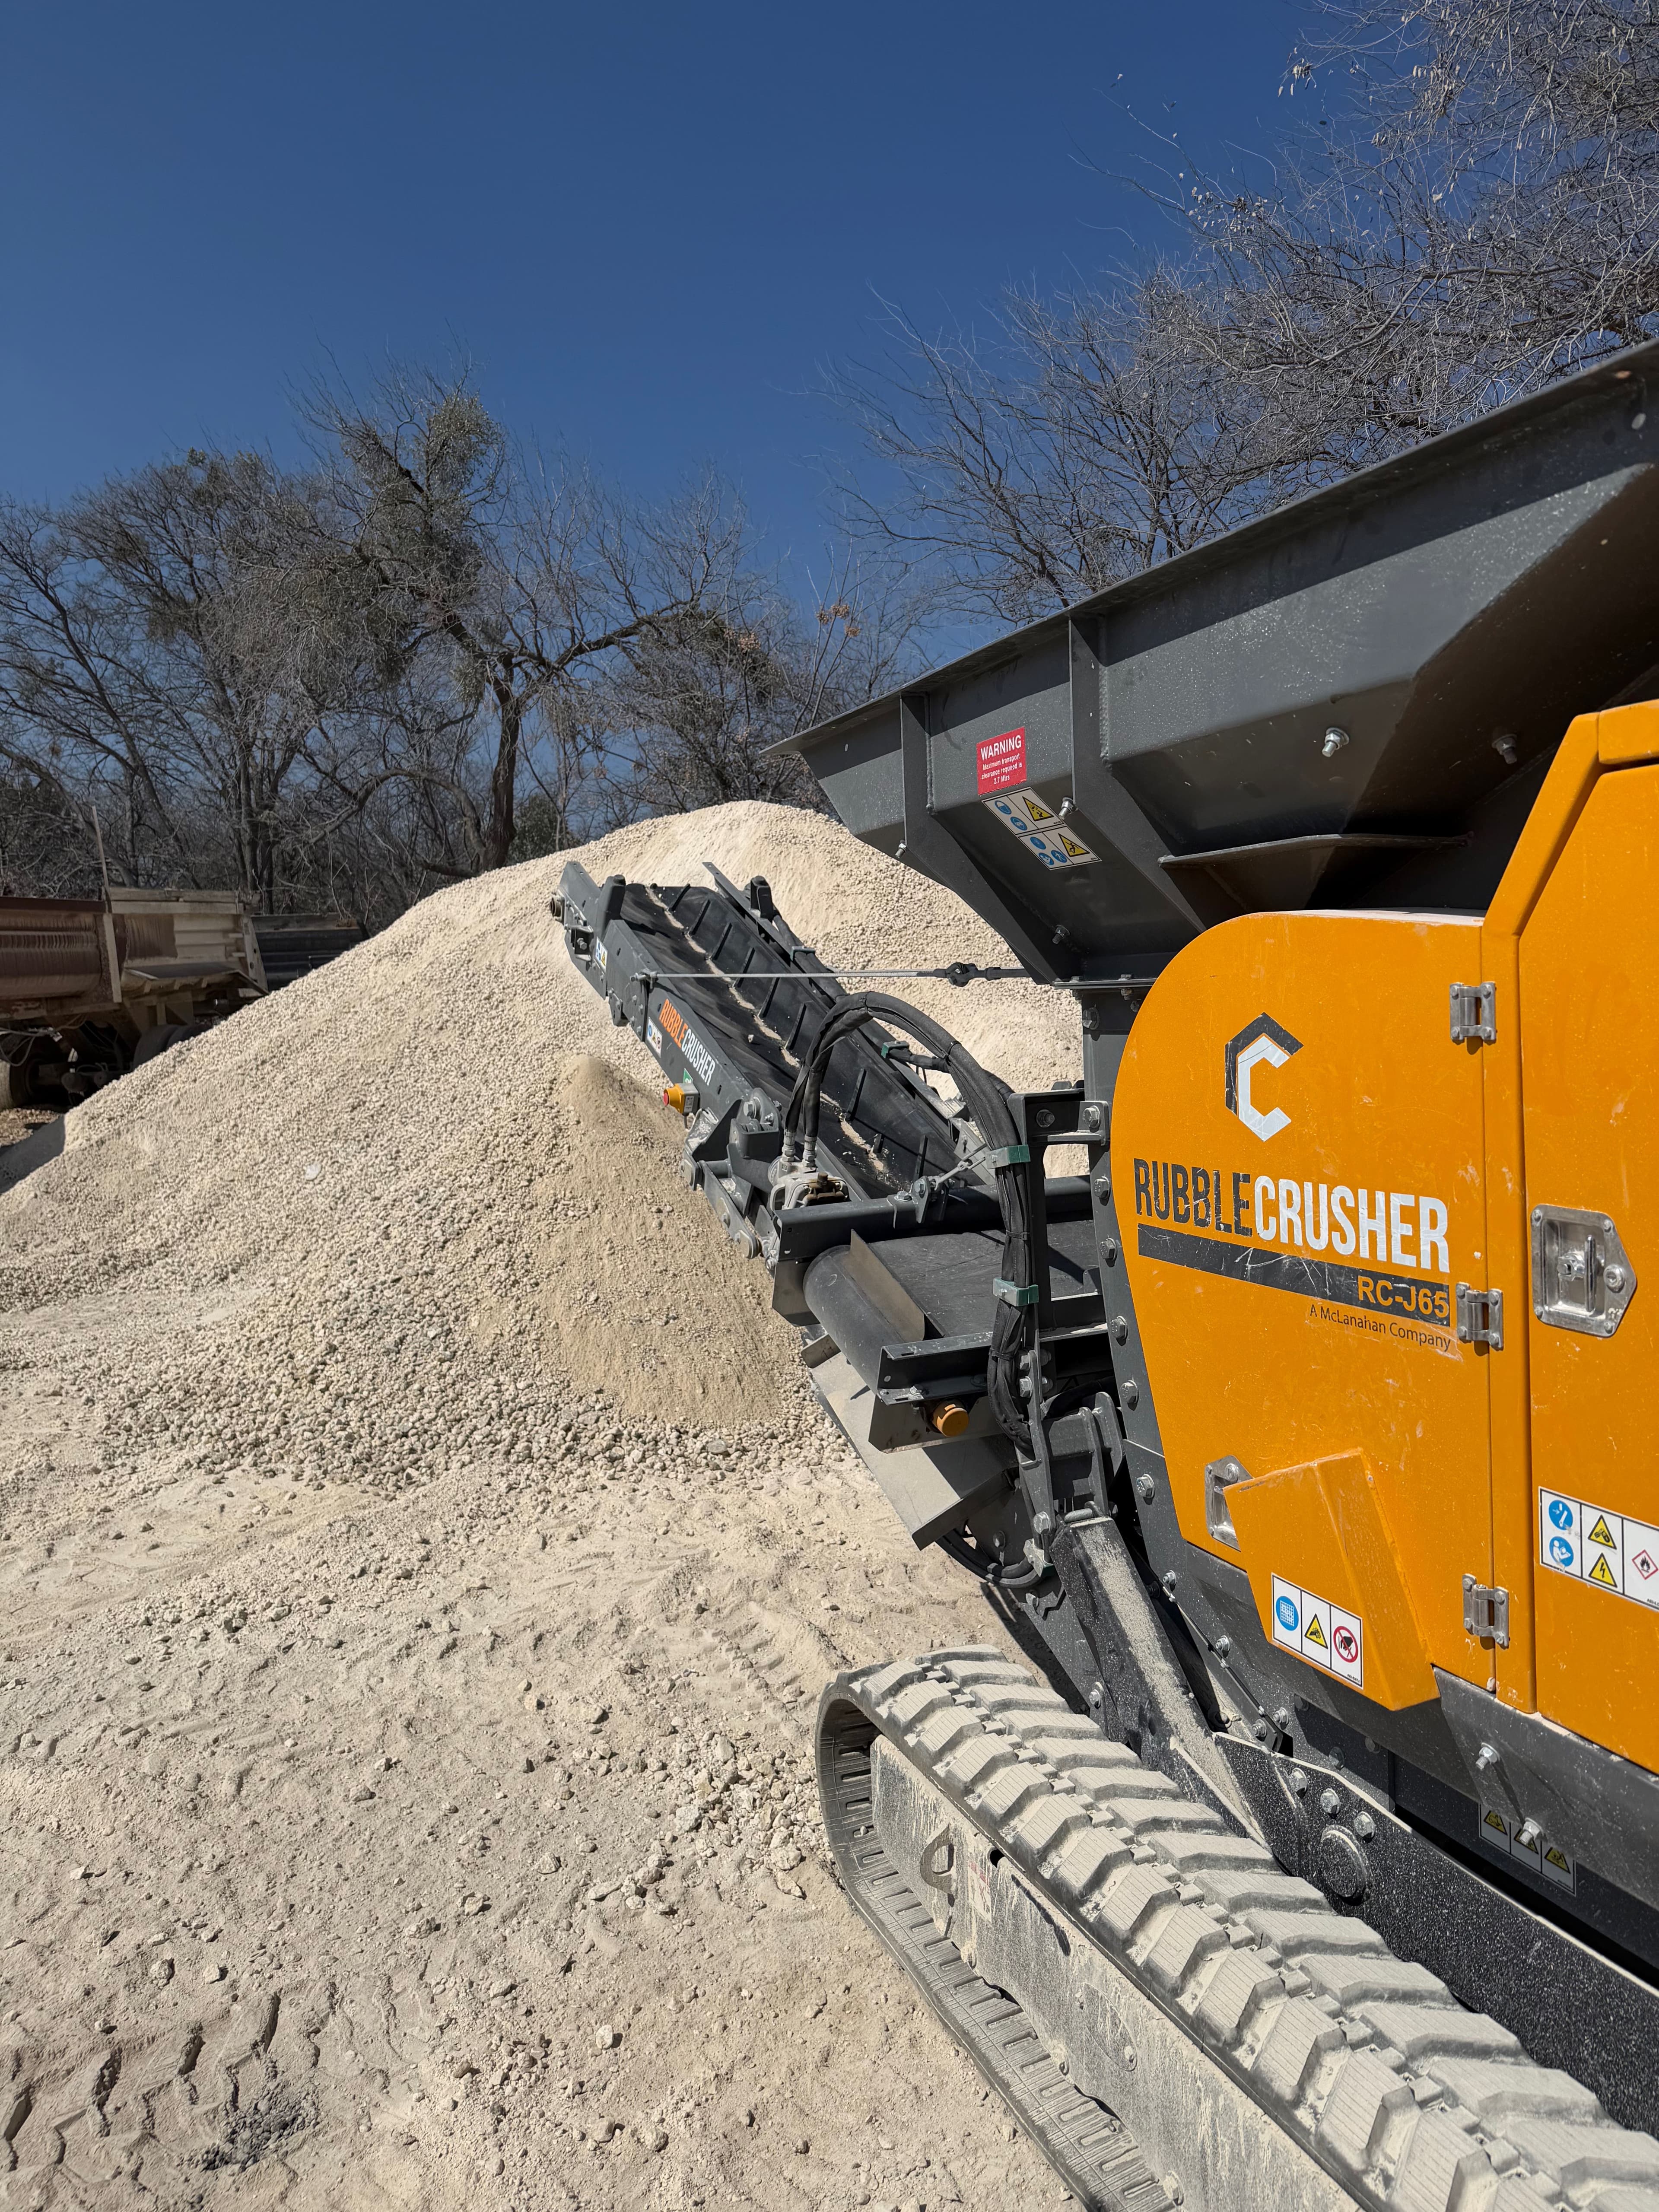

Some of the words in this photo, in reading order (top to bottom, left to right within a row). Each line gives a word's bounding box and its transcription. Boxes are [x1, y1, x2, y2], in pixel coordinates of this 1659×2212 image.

[981, 735, 1021, 760] WARNING
[982, 760, 1001, 770] Maximum
[1002, 753, 1020, 764] transport
[982, 769, 1000, 779] clearance
[1001, 763, 1017, 773] required
[659, 998, 715, 1087] RUBBLECRUSHER
[1134, 1158, 1450, 1273] RUBBLECRUSHER
[1358, 1275, 1449, 1318] RC-J65
[1310, 1304, 1317, 1317] A
[1320, 1306, 1386, 1334] McLanahan
[1389, 1322, 1451, 1352] Company
